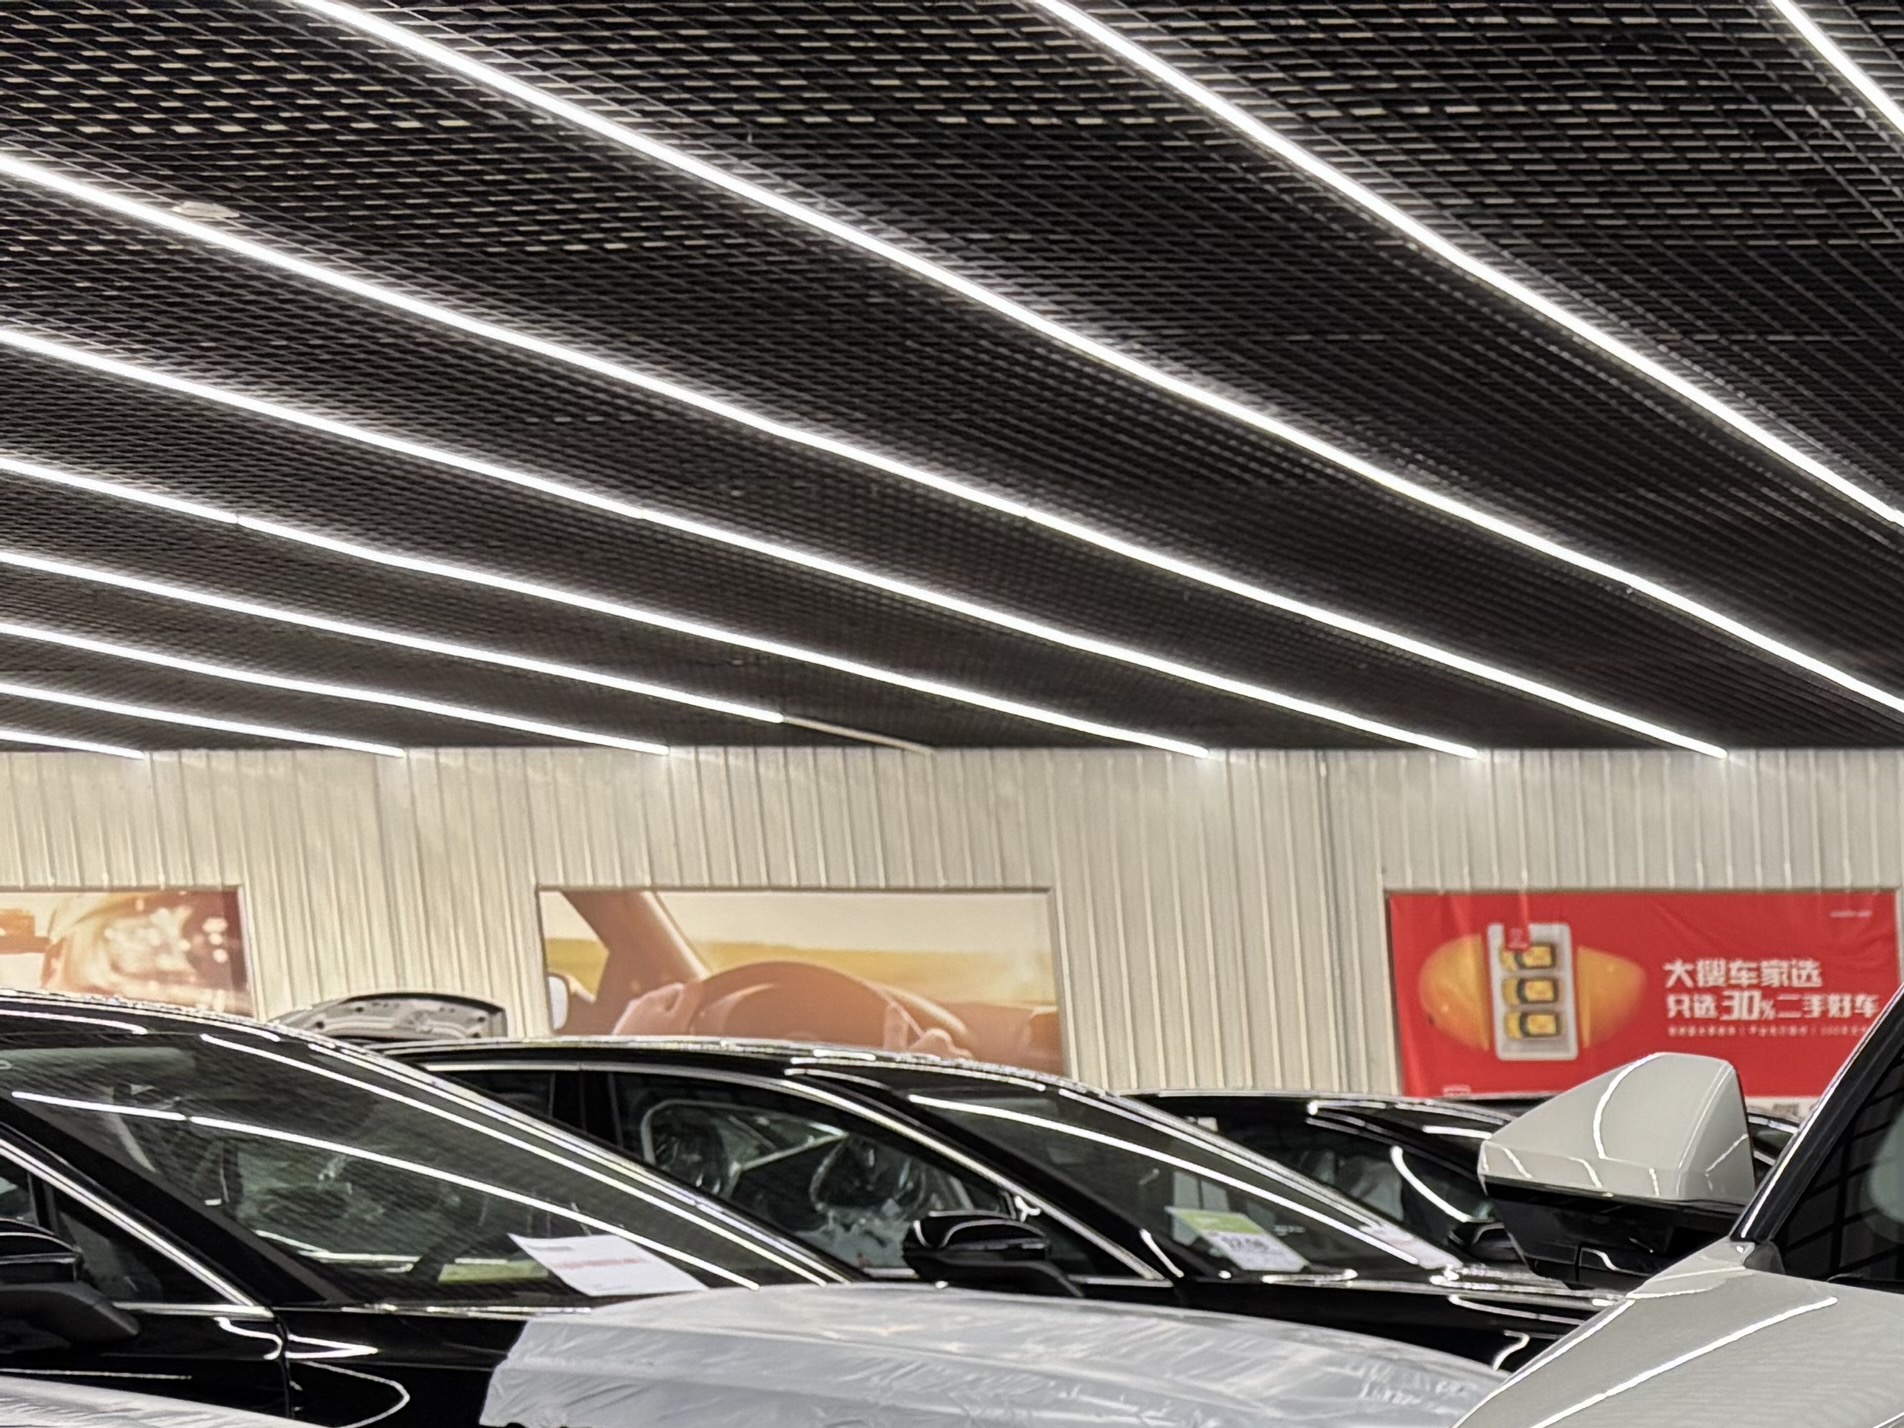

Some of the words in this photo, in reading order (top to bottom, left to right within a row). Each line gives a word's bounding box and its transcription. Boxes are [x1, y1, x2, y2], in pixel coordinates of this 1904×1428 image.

[1663, 958, 1823, 989] 大搜车家选
